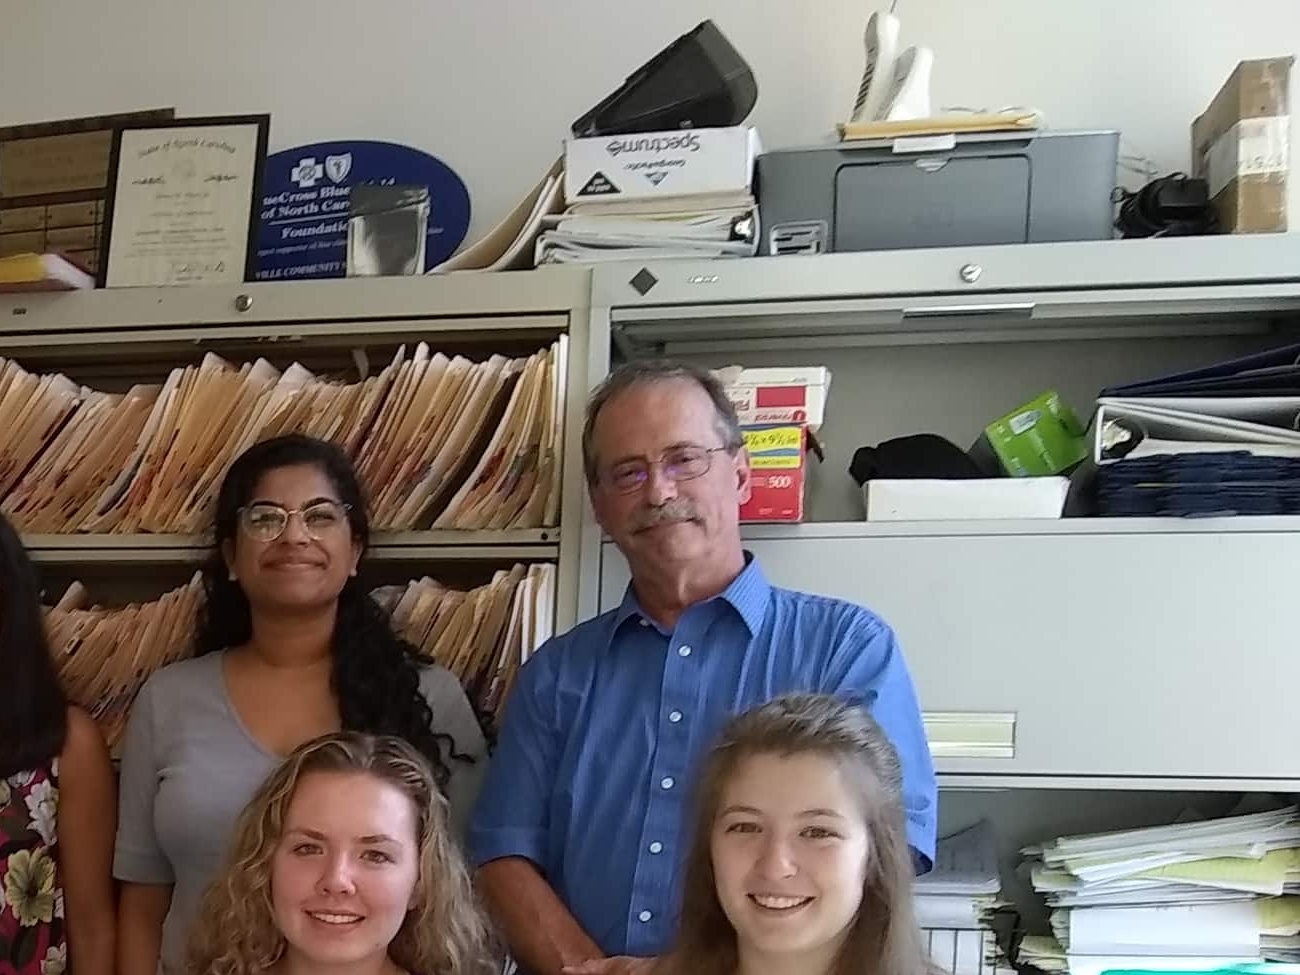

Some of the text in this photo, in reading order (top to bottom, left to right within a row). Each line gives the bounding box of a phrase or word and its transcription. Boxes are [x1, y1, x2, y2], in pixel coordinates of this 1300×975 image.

[262, 186, 351, 206] ueCross Blue
[261, 207, 277, 219] of
[279, 202, 319, 217] North
[769, 475, 791, 489] 500
